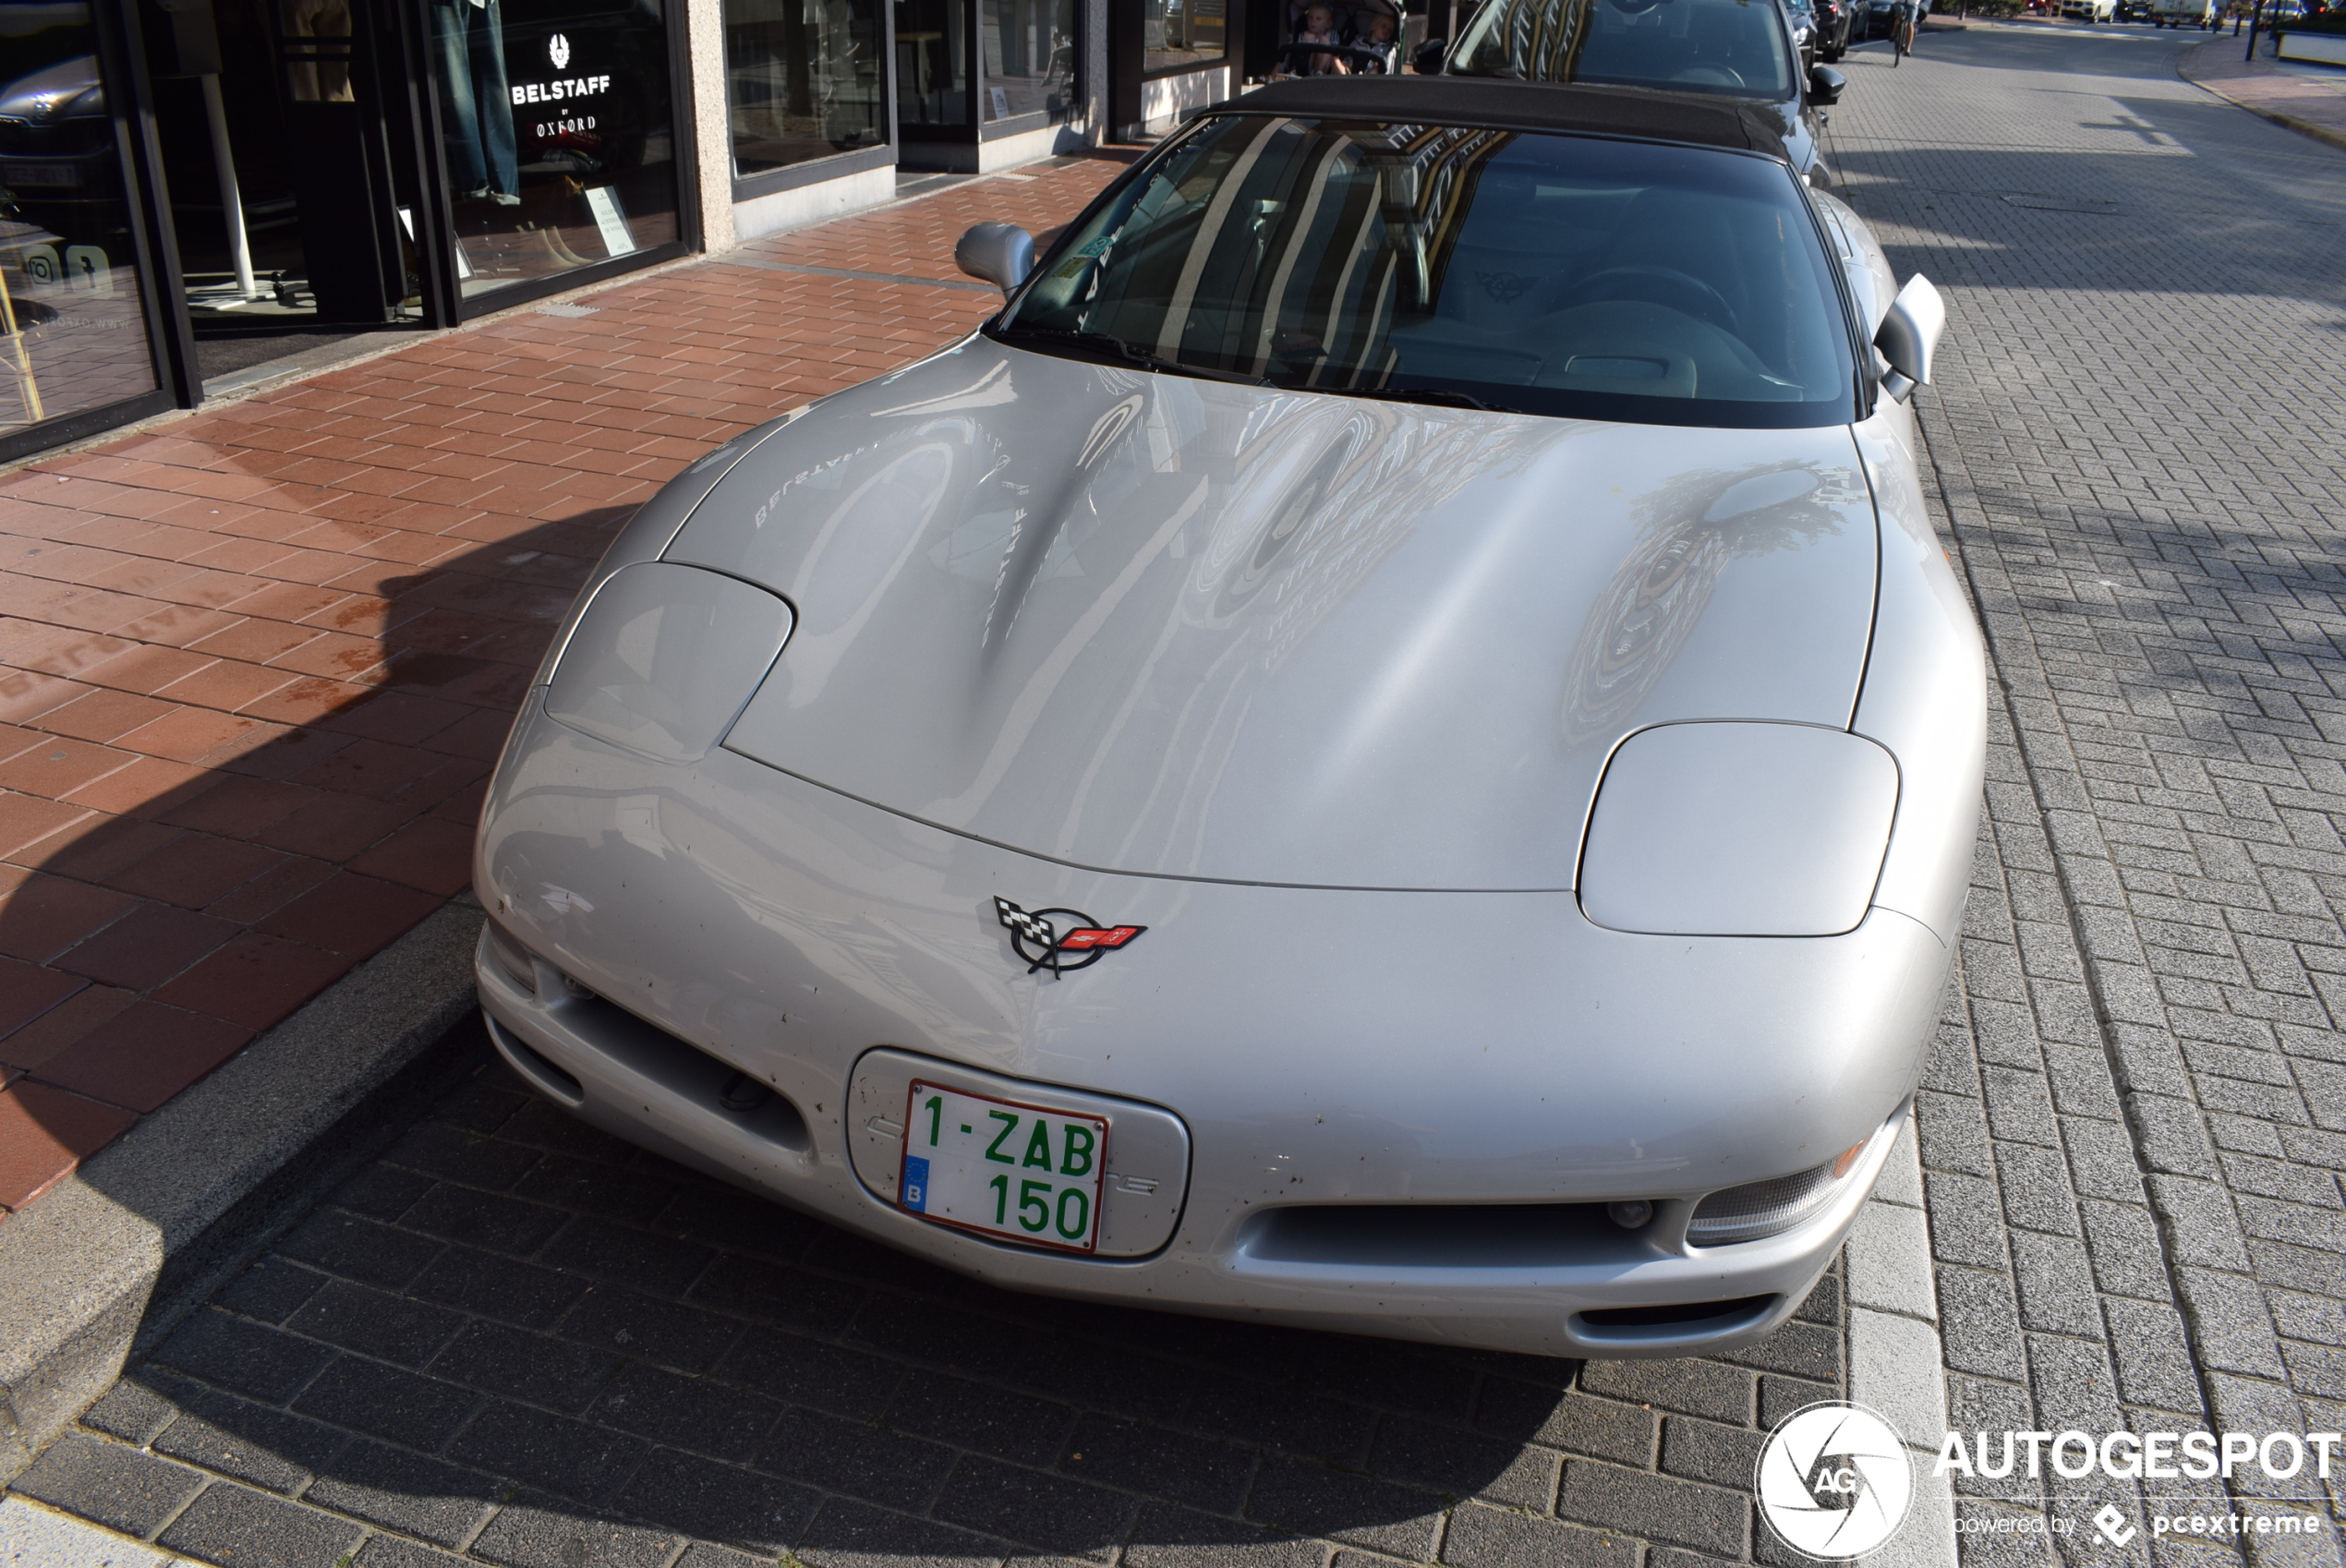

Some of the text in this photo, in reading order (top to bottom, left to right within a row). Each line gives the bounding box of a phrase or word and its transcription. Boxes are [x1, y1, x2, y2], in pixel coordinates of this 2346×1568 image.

[511, 75, 611, 105] BELSTAFF
[925, 1095, 1095, 1177] 1-ZAB
[907, 1185, 922, 1202] B
[989, 1174, 1090, 1240] 150
